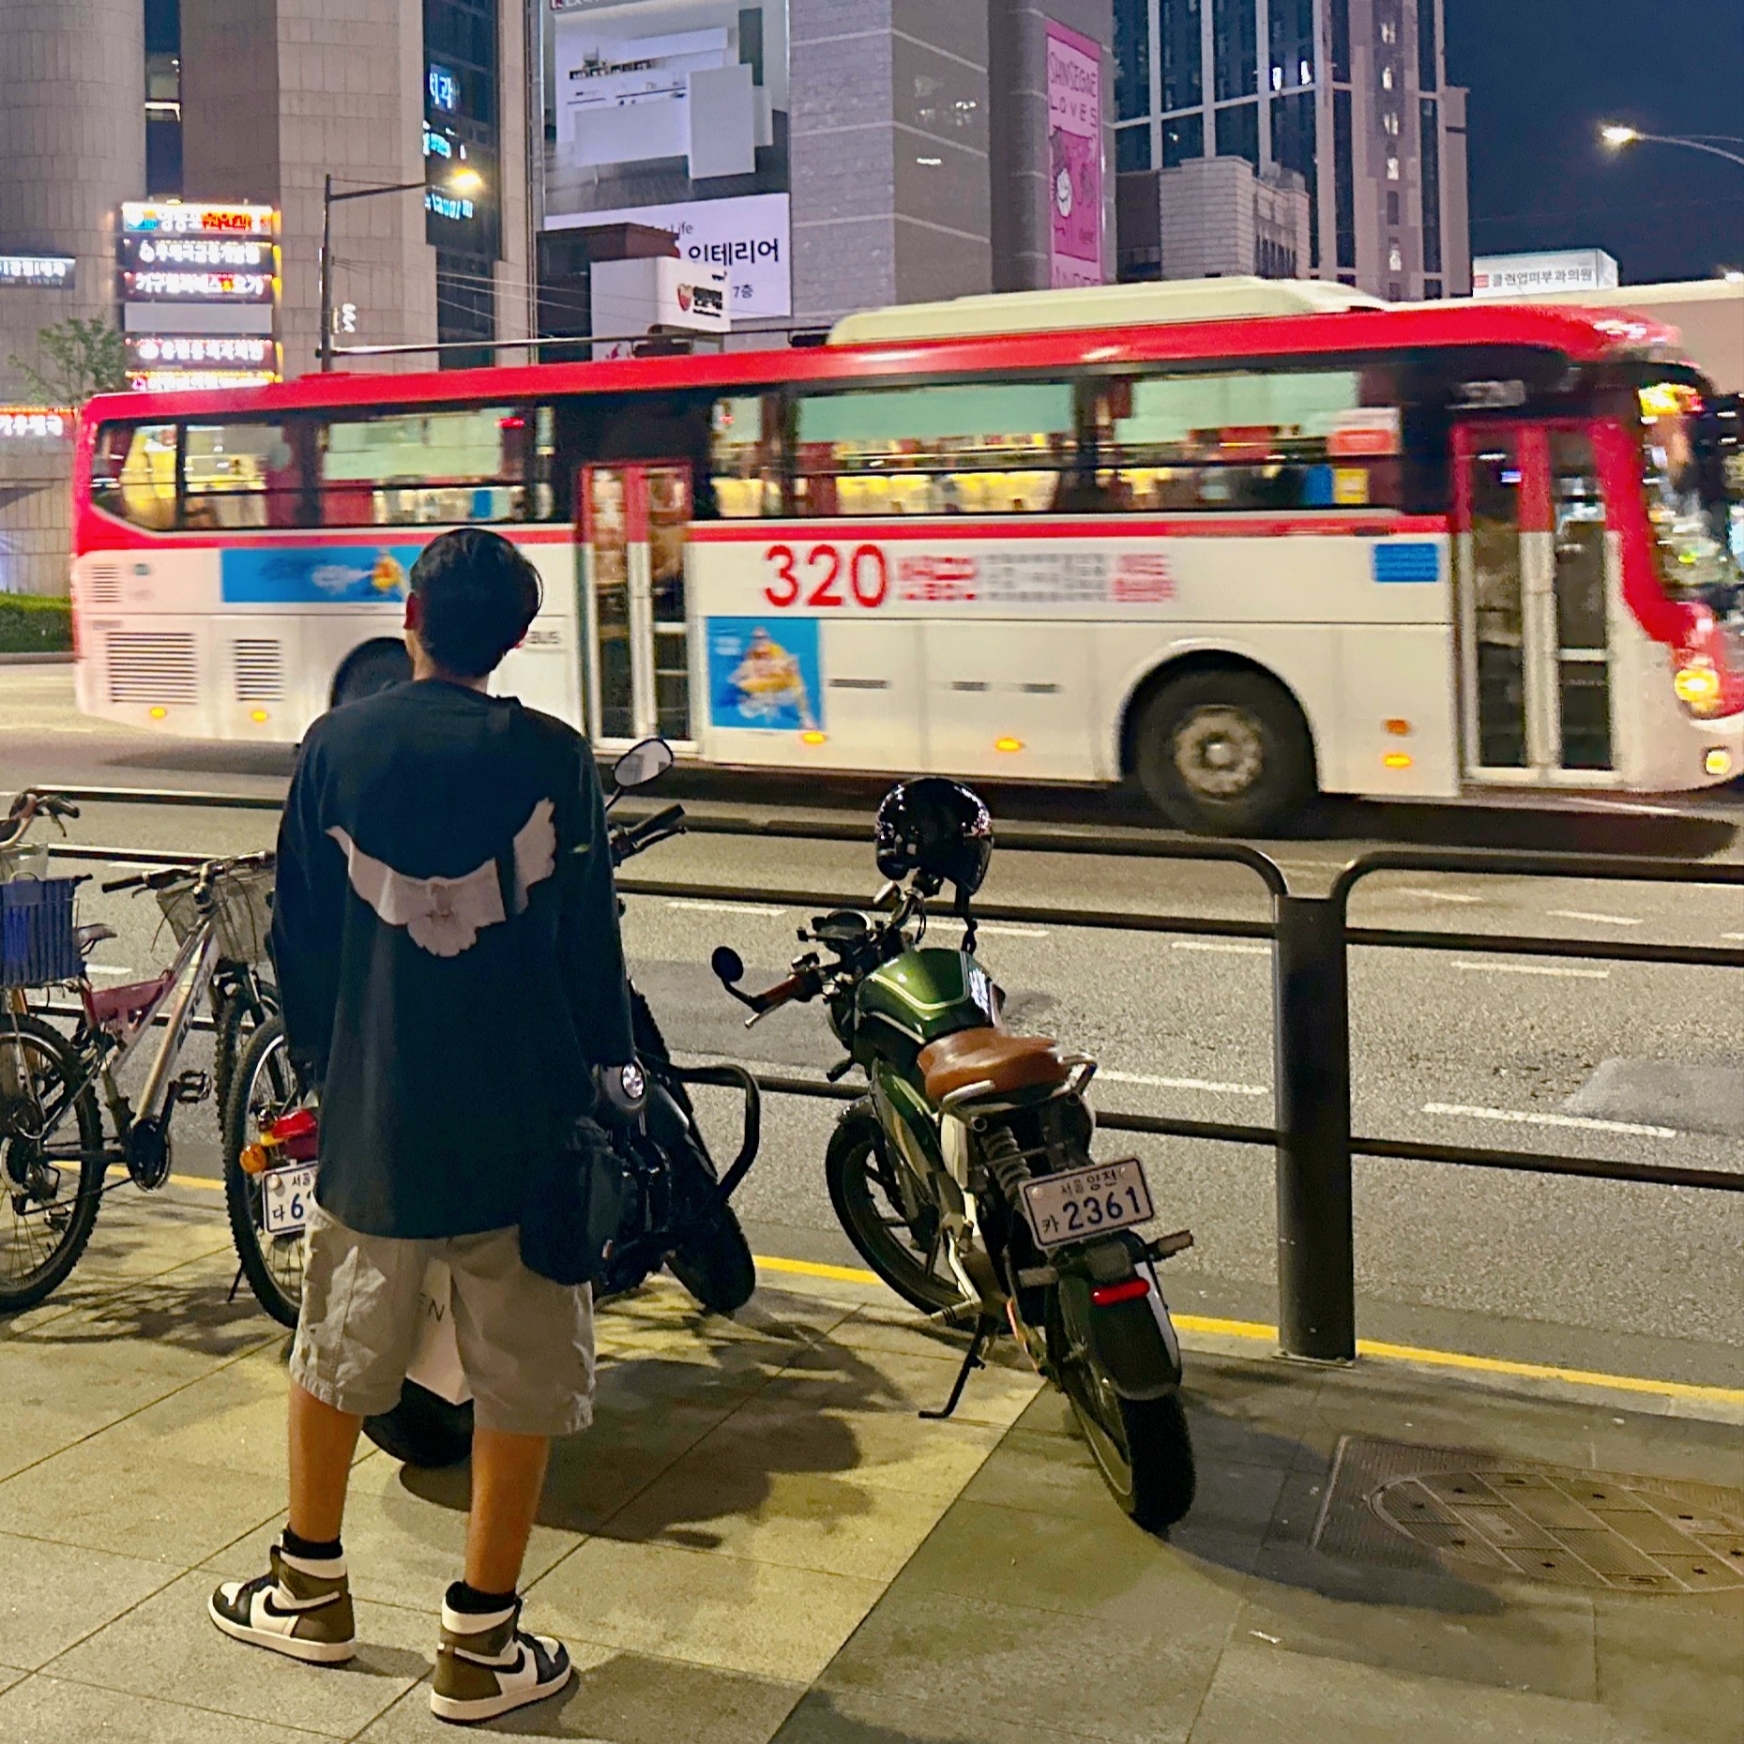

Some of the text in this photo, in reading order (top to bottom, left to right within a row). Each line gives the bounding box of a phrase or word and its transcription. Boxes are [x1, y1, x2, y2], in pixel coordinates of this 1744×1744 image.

[1049, 94, 1097, 128] LOVES
[764, 544, 888, 608] 320
[292, 1172, 311, 1187] 서울
[1063, 1186, 1140, 1230] 2361
